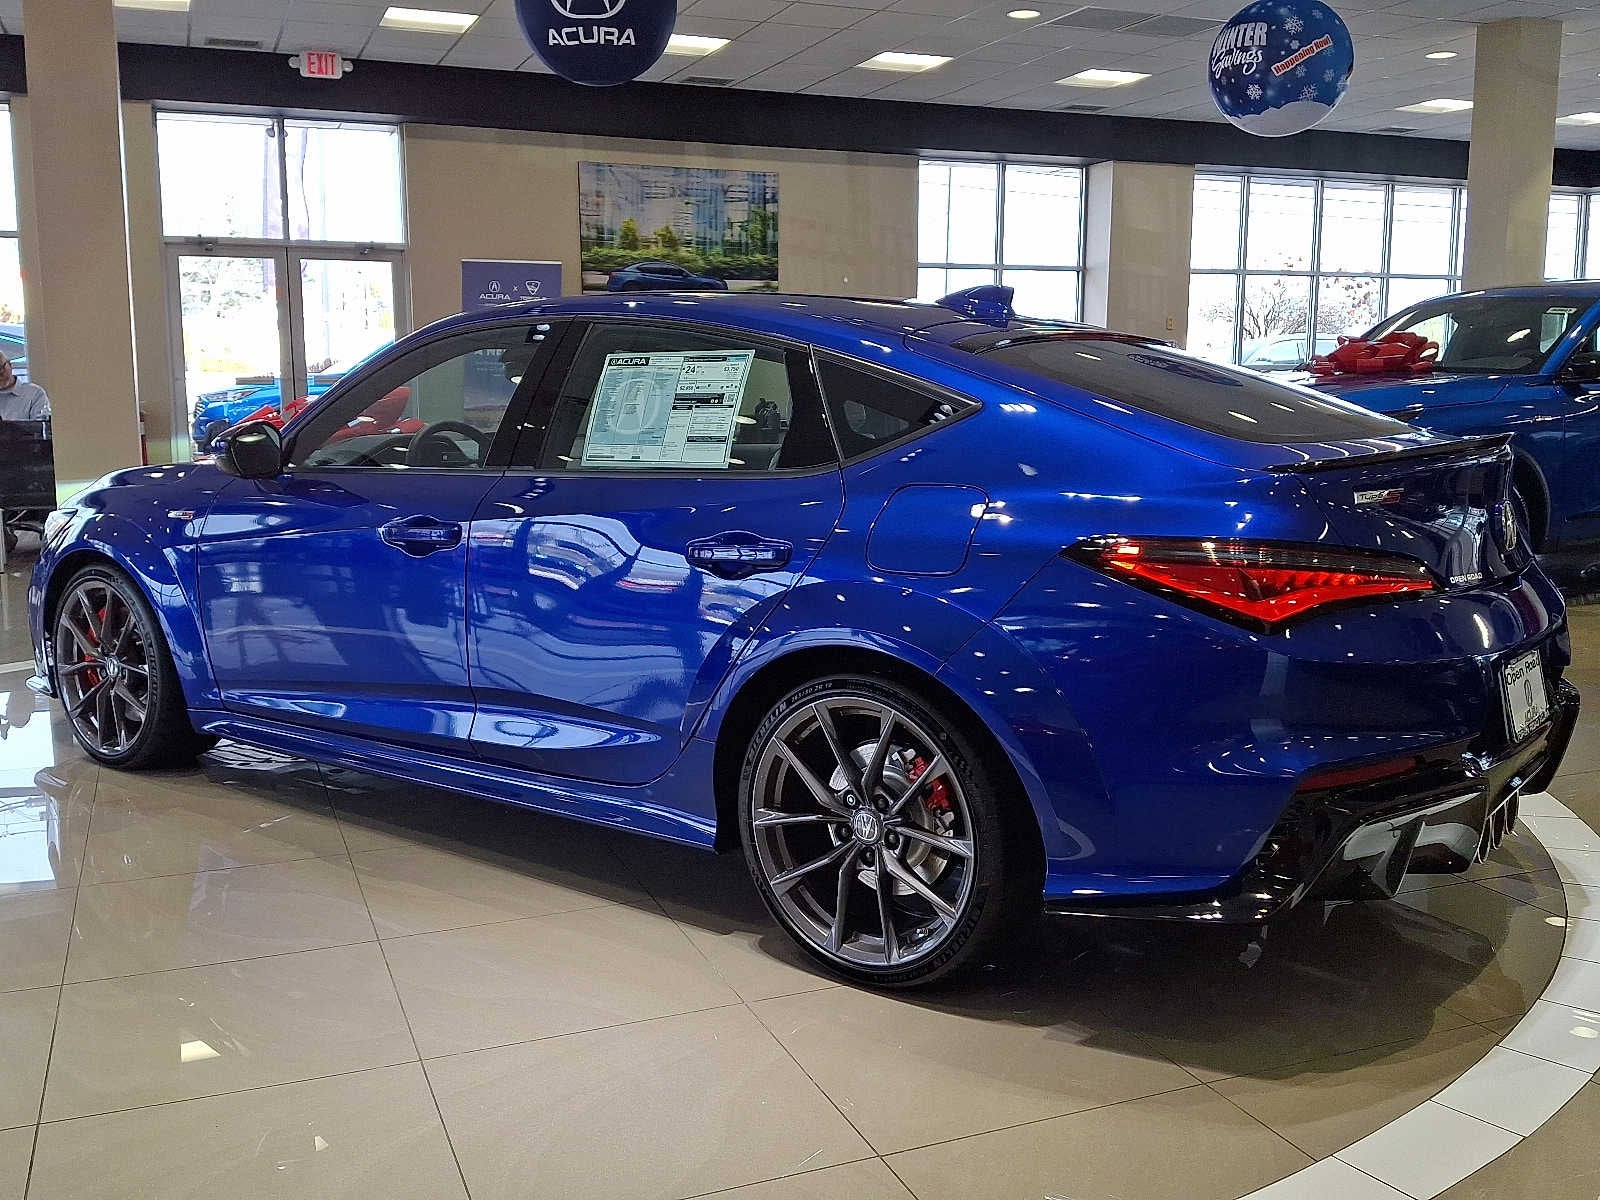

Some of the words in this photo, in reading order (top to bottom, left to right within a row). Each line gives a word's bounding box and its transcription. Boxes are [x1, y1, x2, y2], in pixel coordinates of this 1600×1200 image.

[548, 25, 636, 46] ACURA
[1213, 22, 1268, 57] WINTER
[307, 52, 336, 76] EXIT
[1211, 46, 1263, 79] Savings
[1273, 44, 1316, 75] Happening
[616, 358, 647, 366] ACURA
[685, 365, 696, 374] 24
[1450, 575, 1467, 584] OPEN
[1466, 572, 1483, 581] ROAD
[1505, 669, 1524, 686] Open
